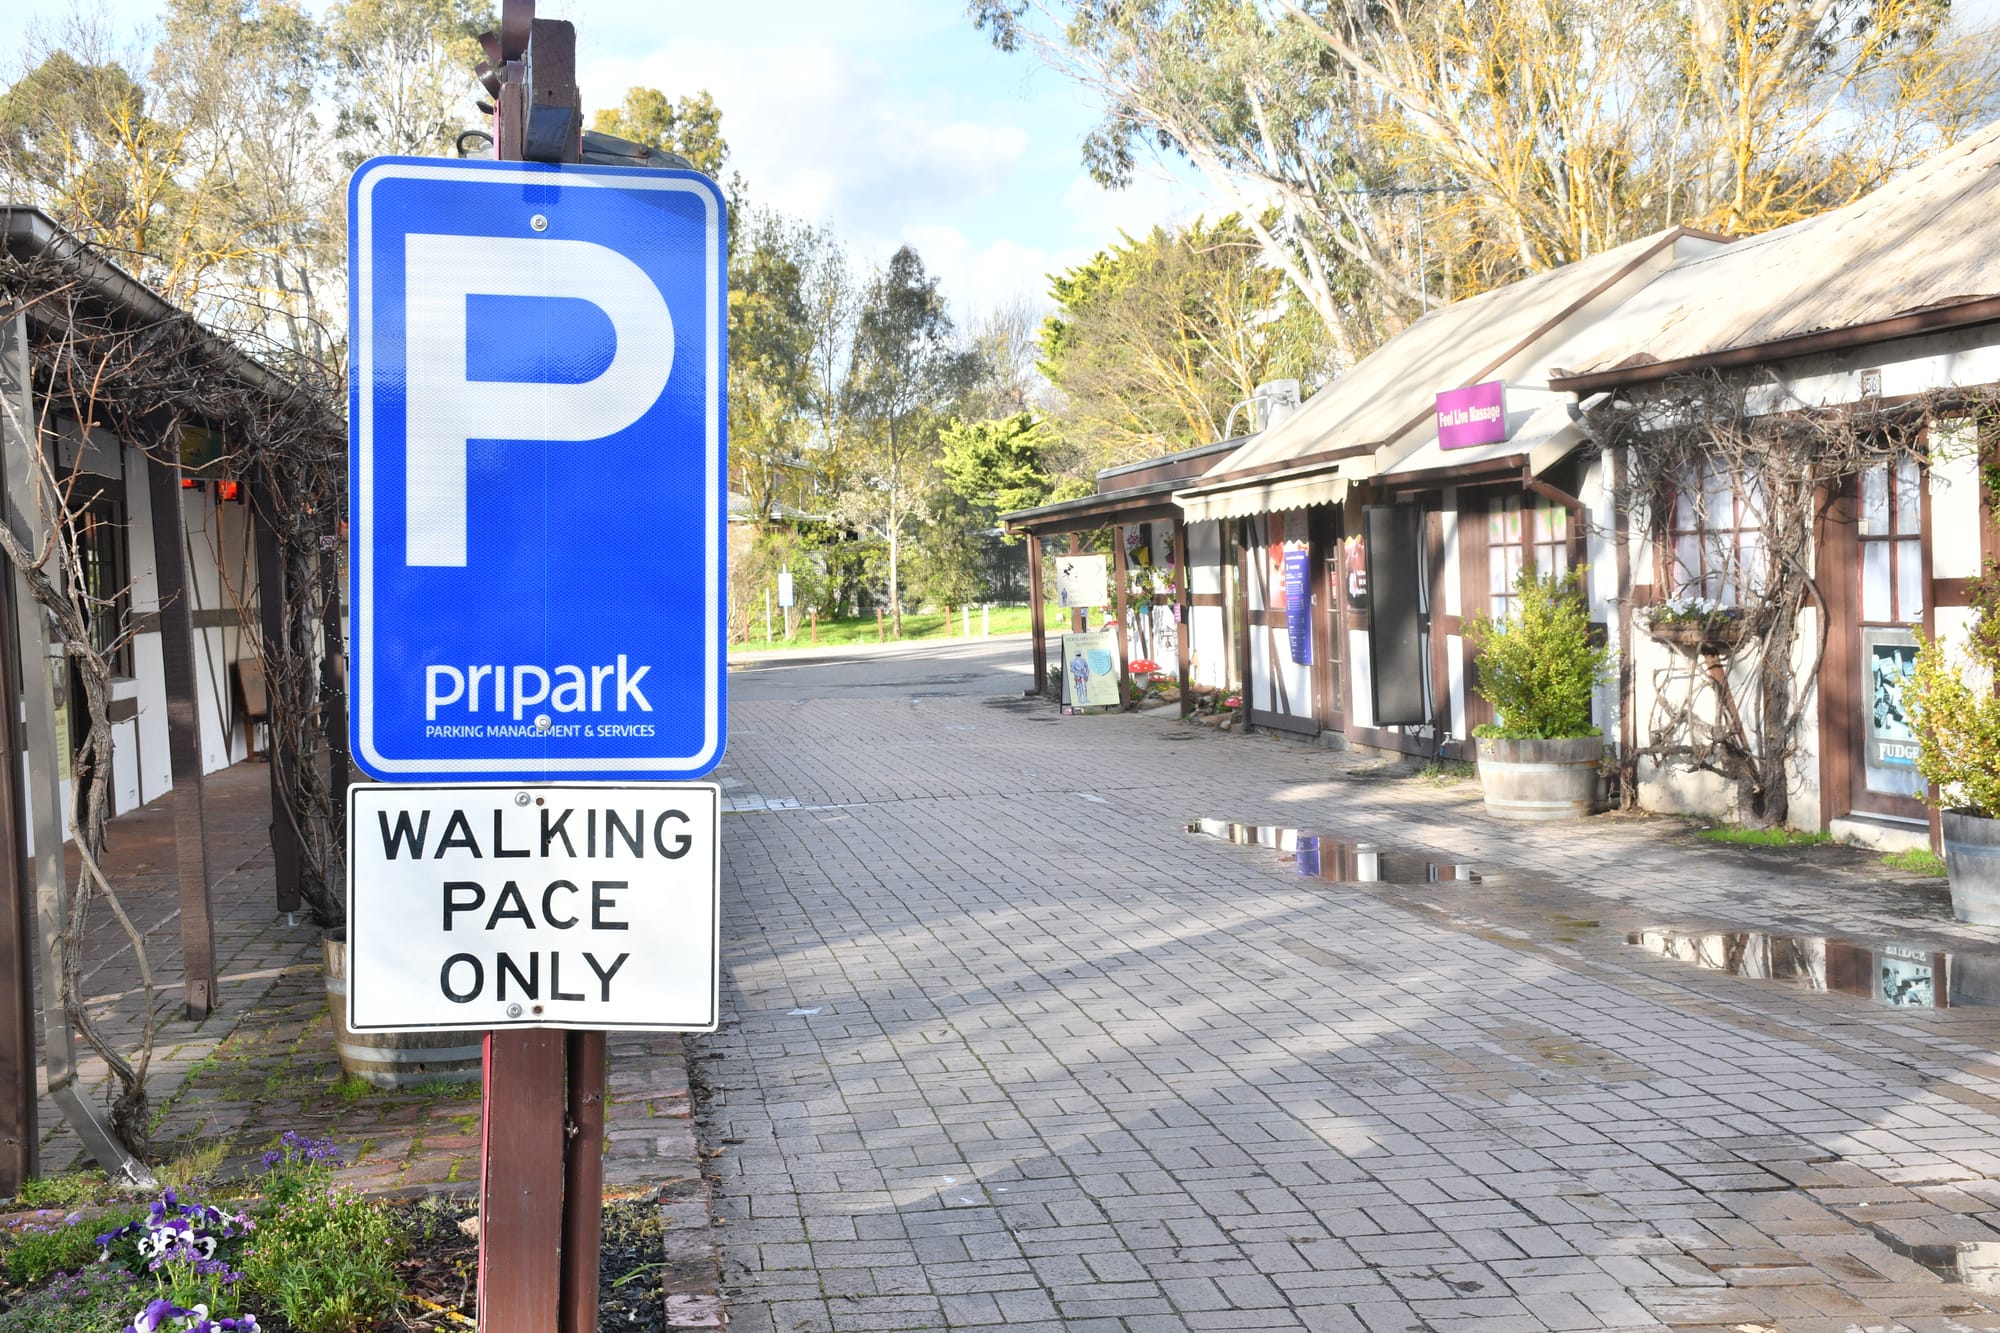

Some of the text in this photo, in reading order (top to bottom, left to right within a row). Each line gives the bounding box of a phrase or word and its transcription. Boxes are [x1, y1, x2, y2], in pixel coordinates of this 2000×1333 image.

[405, 233, 675, 567] P
[1439, 411, 1453, 427] Feel
[1469, 404, 1500, 423] Massage
[426, 654, 653, 720] pripark
[426, 725, 655, 737] PARKING MANAGEMENT & SERVICES
[1879, 743, 1920, 760] FUDGE
[378, 808, 692, 860] WALKING
[443, 880, 629, 931] PACE
[440, 951, 630, 1003] ONLY
